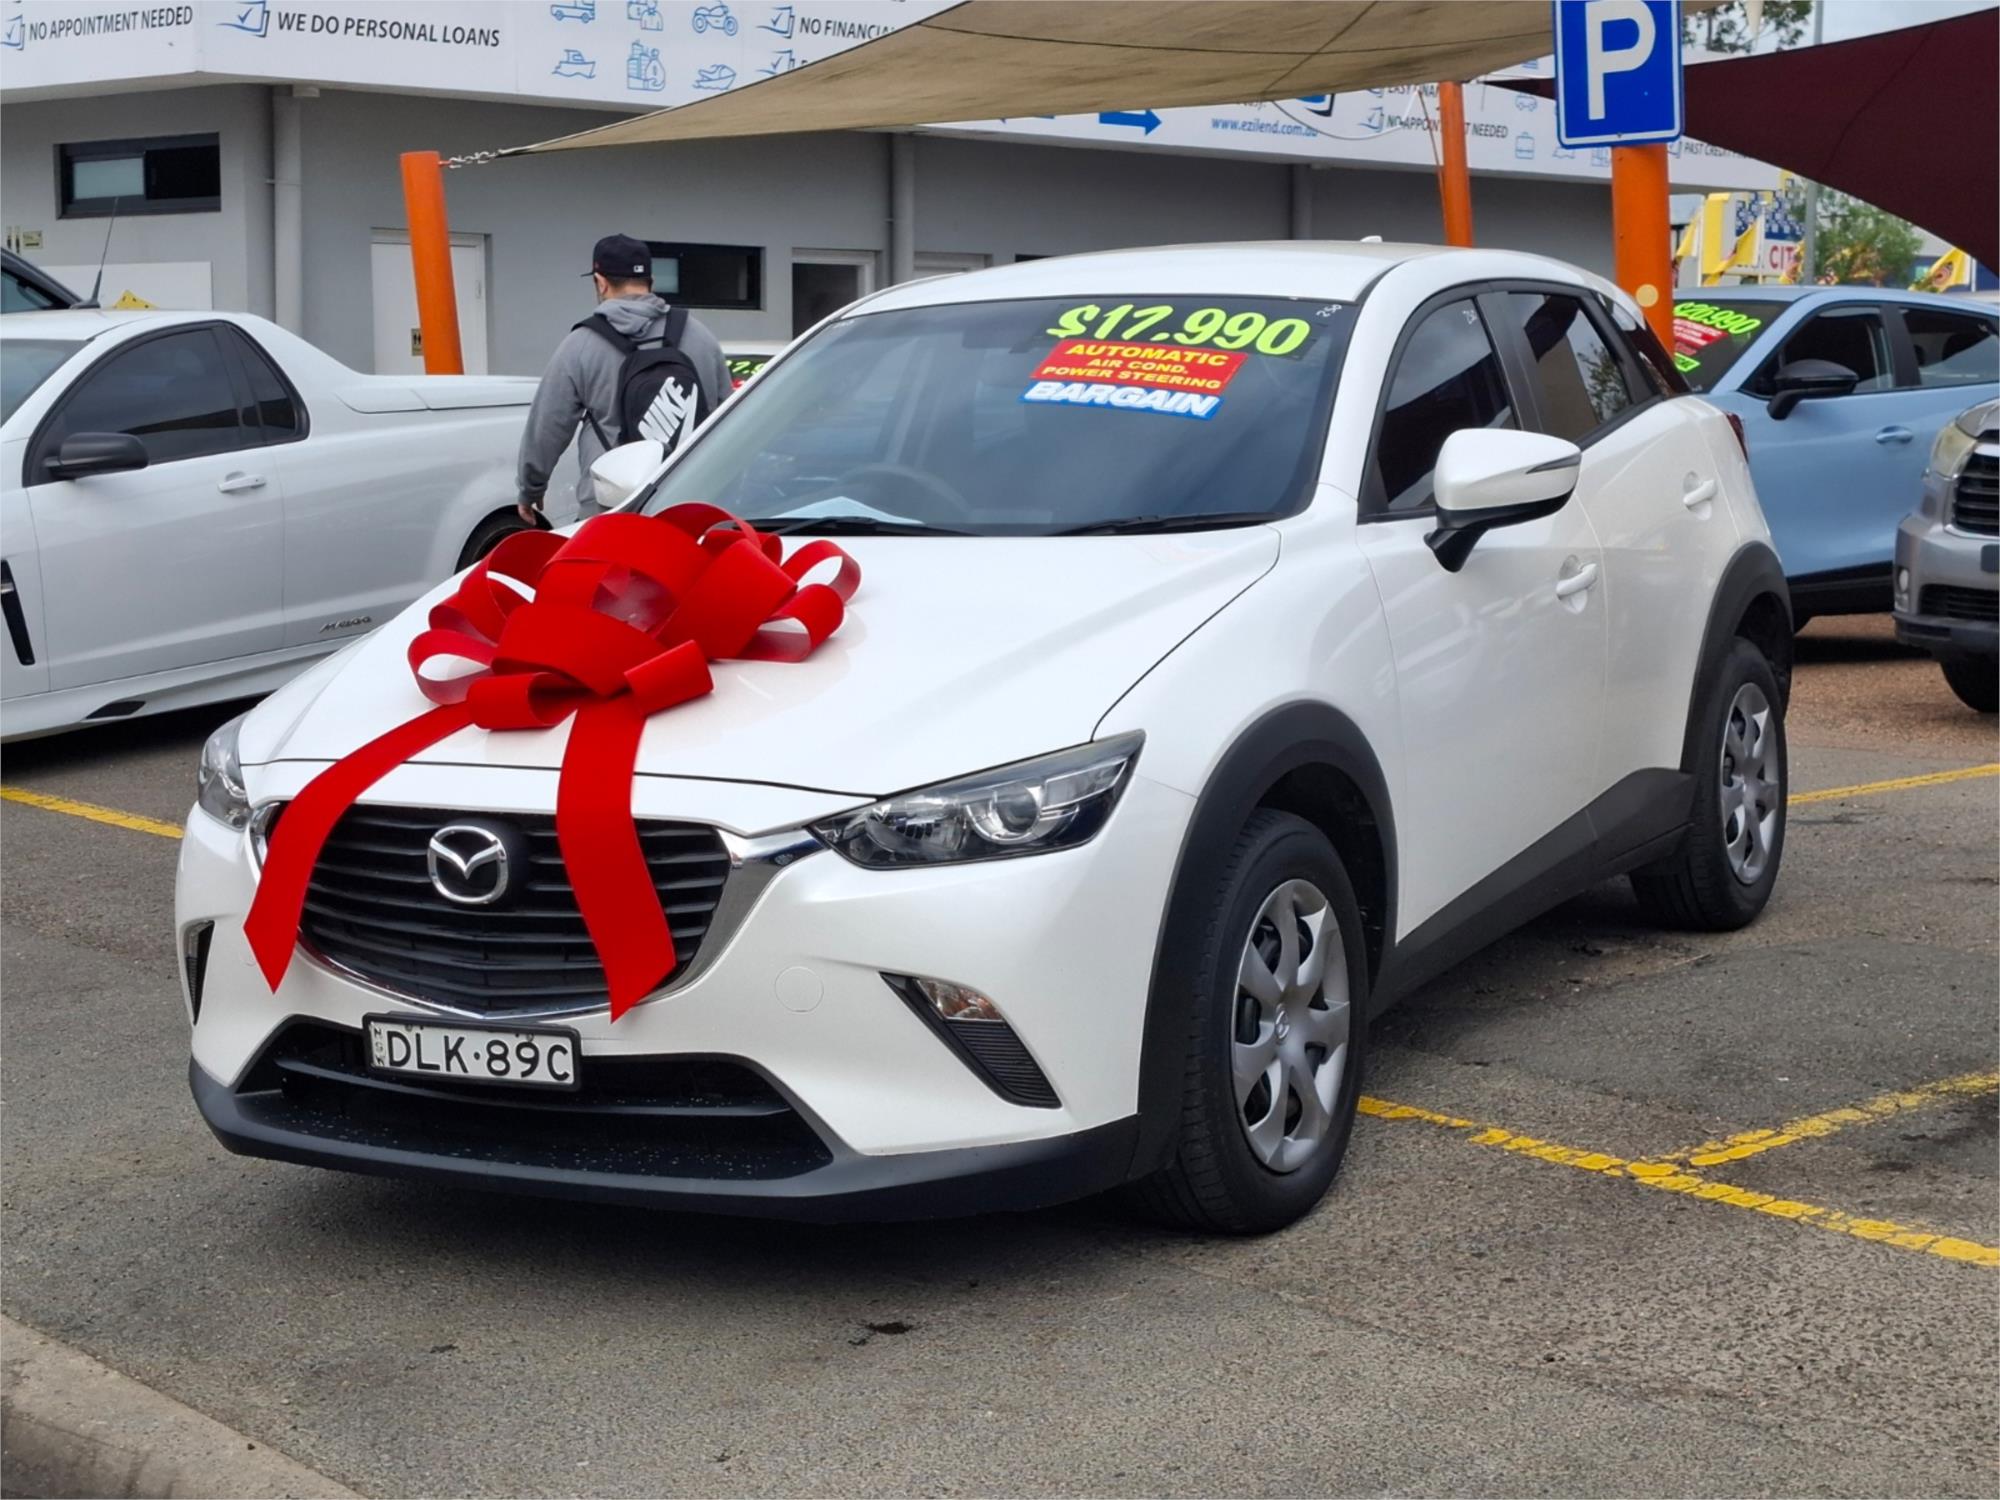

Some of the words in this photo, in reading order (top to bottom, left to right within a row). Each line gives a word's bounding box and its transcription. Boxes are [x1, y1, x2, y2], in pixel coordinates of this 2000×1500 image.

[29, 22, 48, 41] NO
[50, 11, 139, 39] APPOINTMENT
[141, 6, 193, 28] NEEDED
[277, 12, 307, 32] WE
[311, 15, 340, 34] DO
[344, 17, 438, 42] PERSONAL
[442, 25, 500, 47] LOANS
[800, 17, 821, 35] NO
[1585, 0, 1657, 120] P
[1211, 118, 1318, 137] www.ezilend.com.au
[1472, 123, 1509, 138] NEEDED
[1046, 304, 1310, 355] $17.990
[1066, 344, 1230, 367] AUTOMATIC
[1087, 358, 1123, 369] AIR
[1127, 360, 1190, 375] COND.
[1042, 365, 1113, 379] POWER
[1117, 370, 1222, 390] STEERING
[638, 376, 691, 443] NIKE
[1024, 381, 1220, 417] BARGAIN
